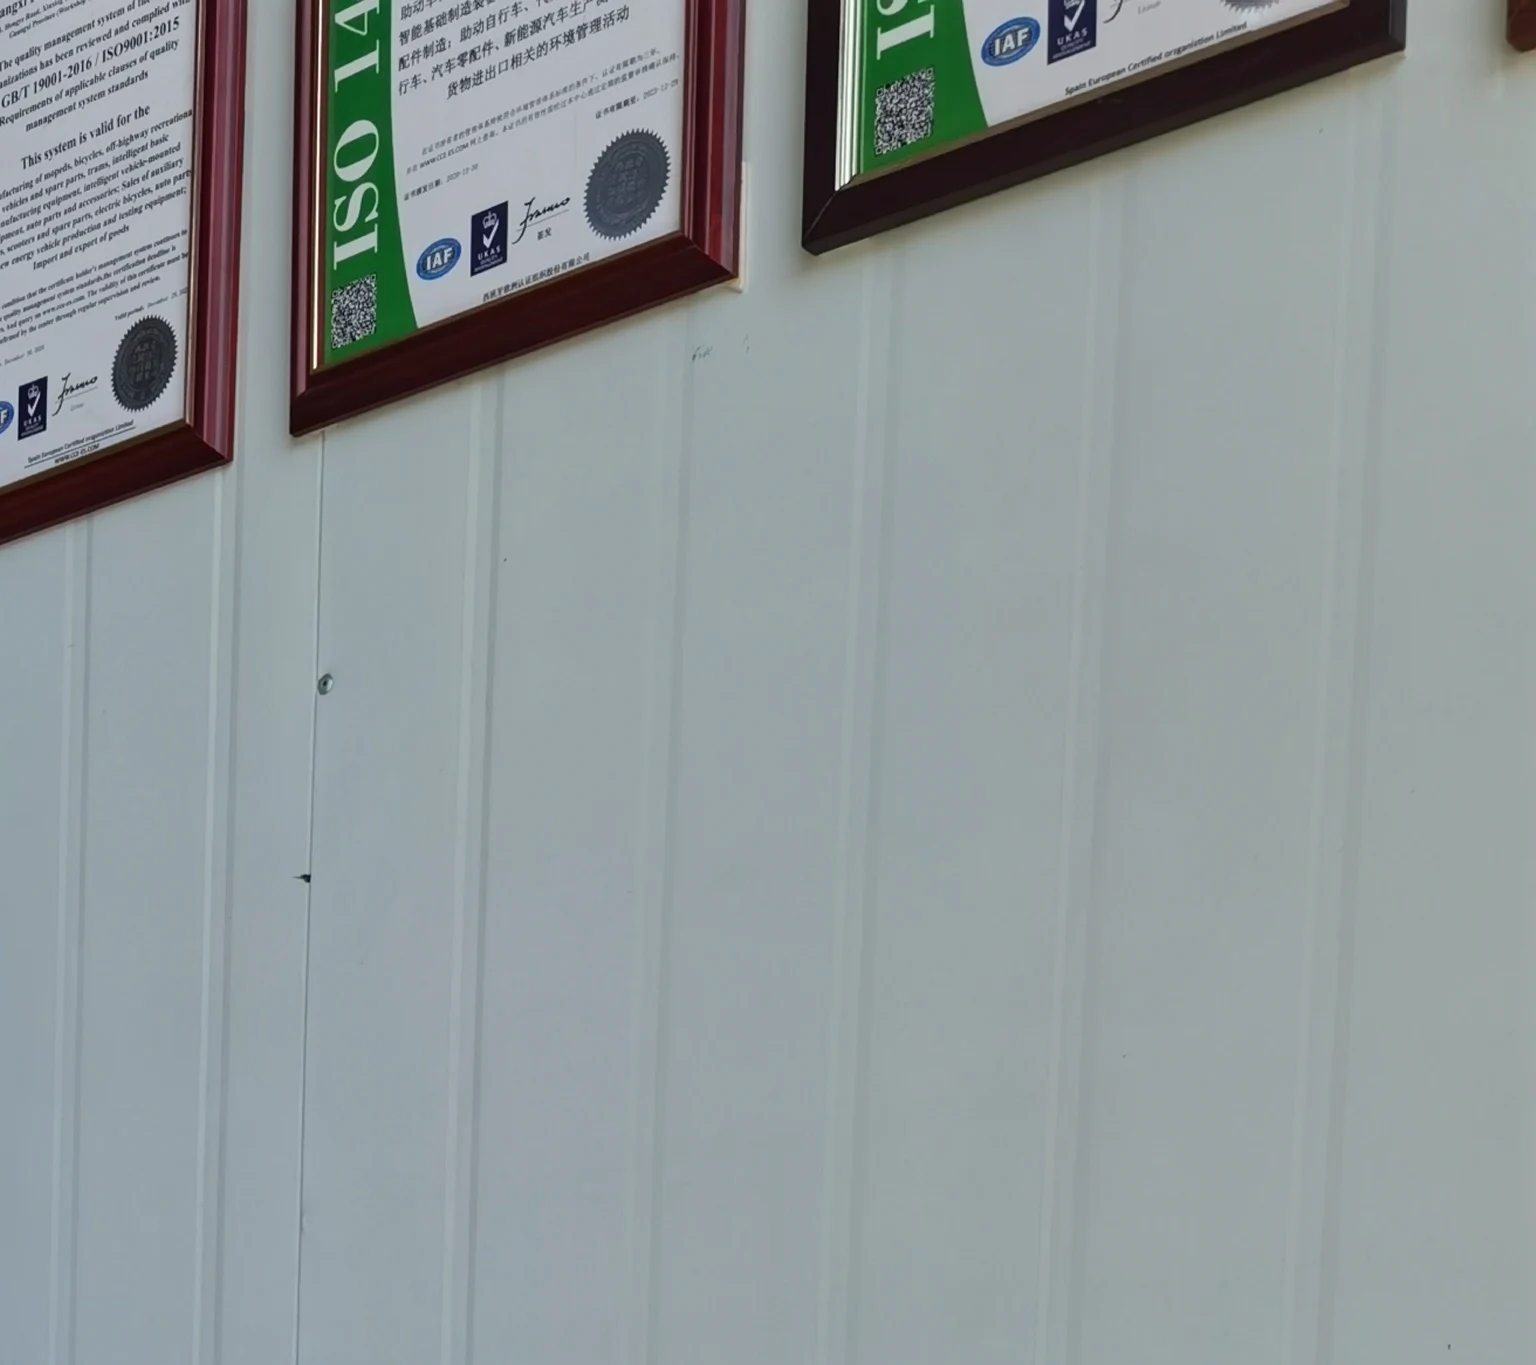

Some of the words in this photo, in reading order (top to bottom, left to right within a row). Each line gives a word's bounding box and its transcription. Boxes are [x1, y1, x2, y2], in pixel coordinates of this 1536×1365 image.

[1, 85, 28, 107] GB/T
[33, 58, 92, 93] 19001-2016
[102, 16, 179, 62] ISO9001:2015
[14, 46, 41, 65] quality
[43, 20, 95, 50] management
[96, 7, 125, 26] system
[126, 0, 135, 11] of
[39, 58, 53, 70] has
[54, 48, 74, 62] been
[75, 28, 112, 53] reviewed
[113, 20, 130, 36] and
[131, 2, 170, 27] complied
[447, 5, 630, 100] 货物进出口相关的环境管理活动
[993, 27, 1030, 56] IAF
[1057, 28, 1088, 46] UKAS
[54, 88, 63, 101] of
[64, 72, 106, 97] applicable
[107, 58, 137, 77] clauses
[138, 50, 148, 63] of
[149, 40, 178, 59] quality
[1087, 67, 1126, 86] European
[1127, 52, 1163, 71] Certified
[25, 102, 76, 131] management
[77, 90, 106, 108] system
[107, 70, 148, 94] standards
[21, 152, 42, 169] This
[43, 138, 76, 160] system
[78, 132, 87, 144] is
[89, 118, 114, 137] valid
[116, 113, 131, 127] for
[133, 106, 150, 119] the
[83, 170, 119, 191] intelligent
[120, 142, 180, 174] vehicle-mounted
[1, 196, 28, 212] vehicles
[29, 187, 43, 200] and
[44, 181, 64, 195] spare
[111, 142, 148, 164] intelligent
[149, 134, 169, 148] basic
[25, 219, 42, 230] auto
[42, 211, 61, 226] parts
[63, 202, 77, 215] and
[121, 177, 140, 190] Sales
[141, 170, 149, 181] of
[34, 172, 42, 184] of
[333, 119, 380, 270] ISO
[6, 236, 35, 252] scooters
[36, 227, 50, 240] and
[51, 220, 71, 235] spare
[94, 199, 121, 215] electric
[154, 178, 171, 190] auto
[11, 250, 34, 264] energy
[36, 238, 60, 253] vehicle
[61, 222, 101, 245] production
[102, 213, 117, 226] and
[118, 204, 143, 219] testing
[32, 253, 58, 269] Import
[59, 246, 73, 259] and
[74, 237, 98, 252] export
[99, 231, 107, 242] of
[107, 224, 129, 241] goods
[424, 250, 453, 271] IAF
[477, 245, 501, 260] UKAS
